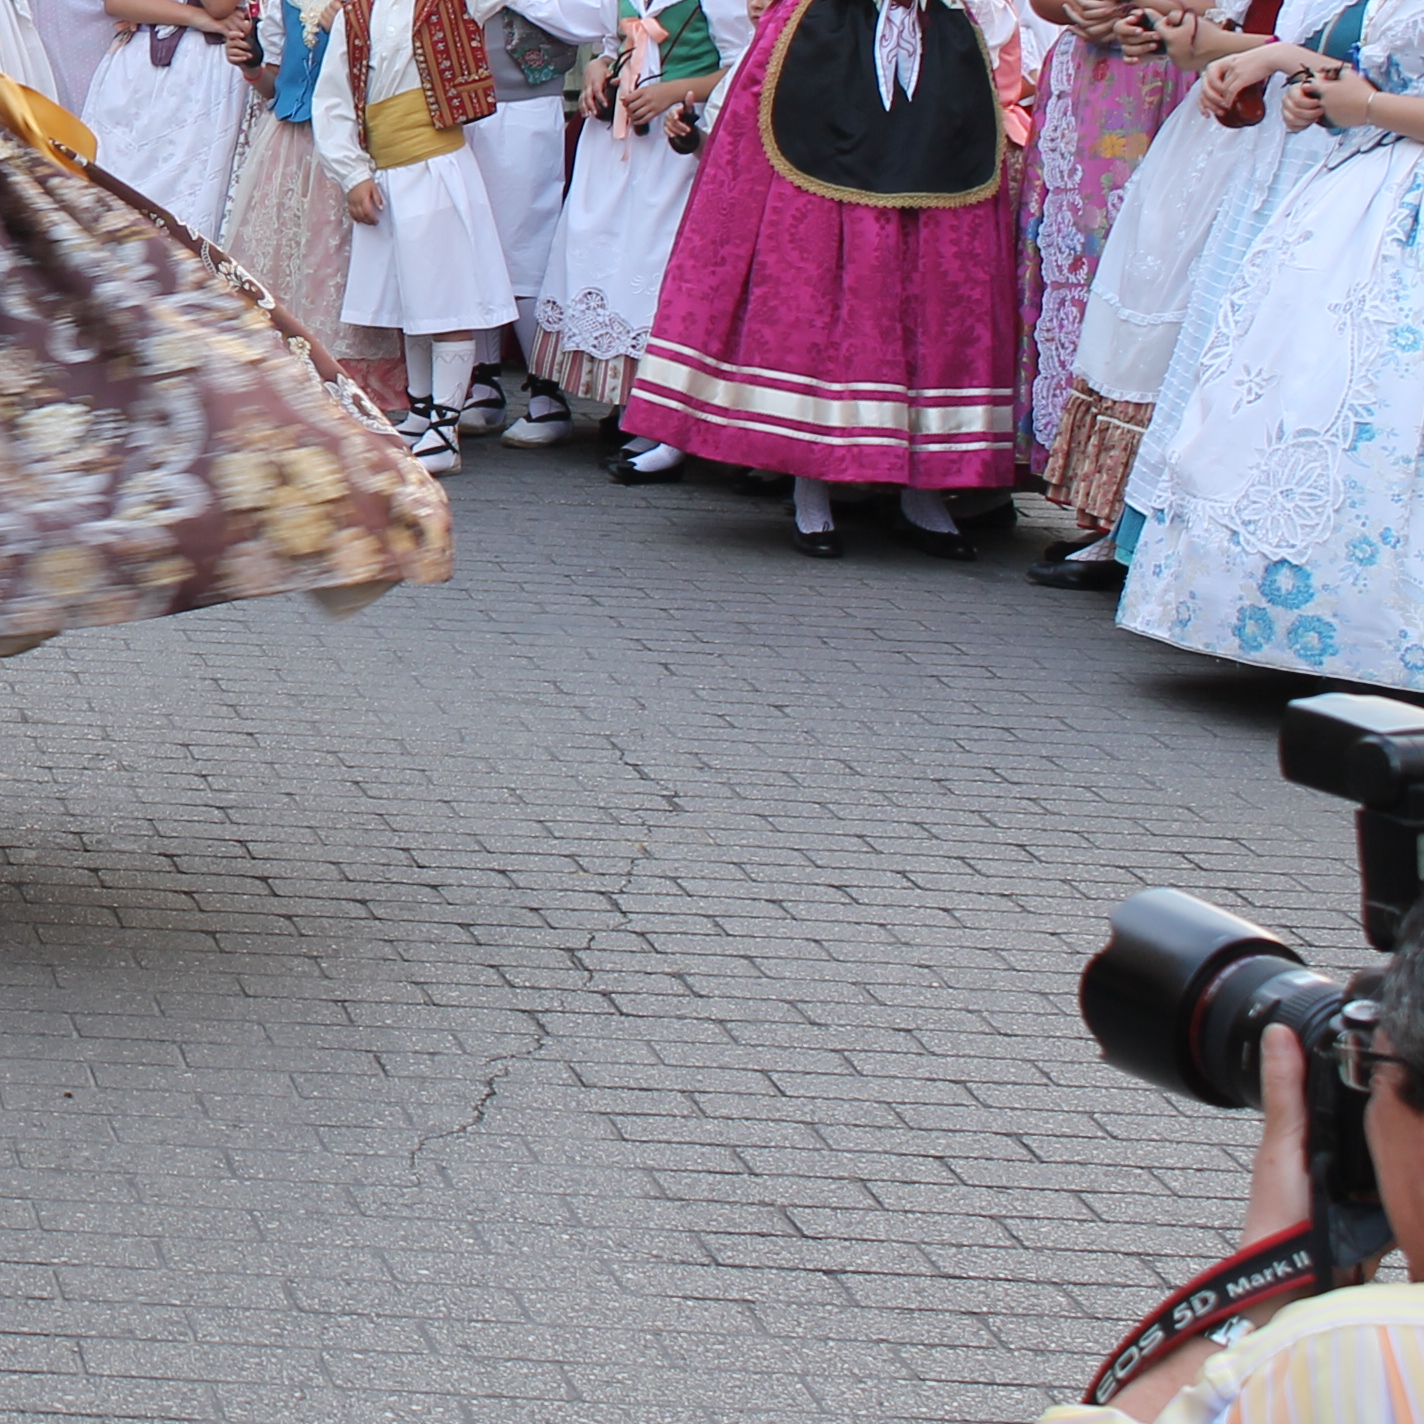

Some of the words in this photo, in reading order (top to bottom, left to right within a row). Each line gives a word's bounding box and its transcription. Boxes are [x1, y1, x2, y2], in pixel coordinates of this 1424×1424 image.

[1095, 1323, 1166, 1404] EOS
[1172, 1289, 1221, 1331] 5D
[1225, 1259, 1293, 1299] Mark
[1292, 1249, 1313, 1268] II
